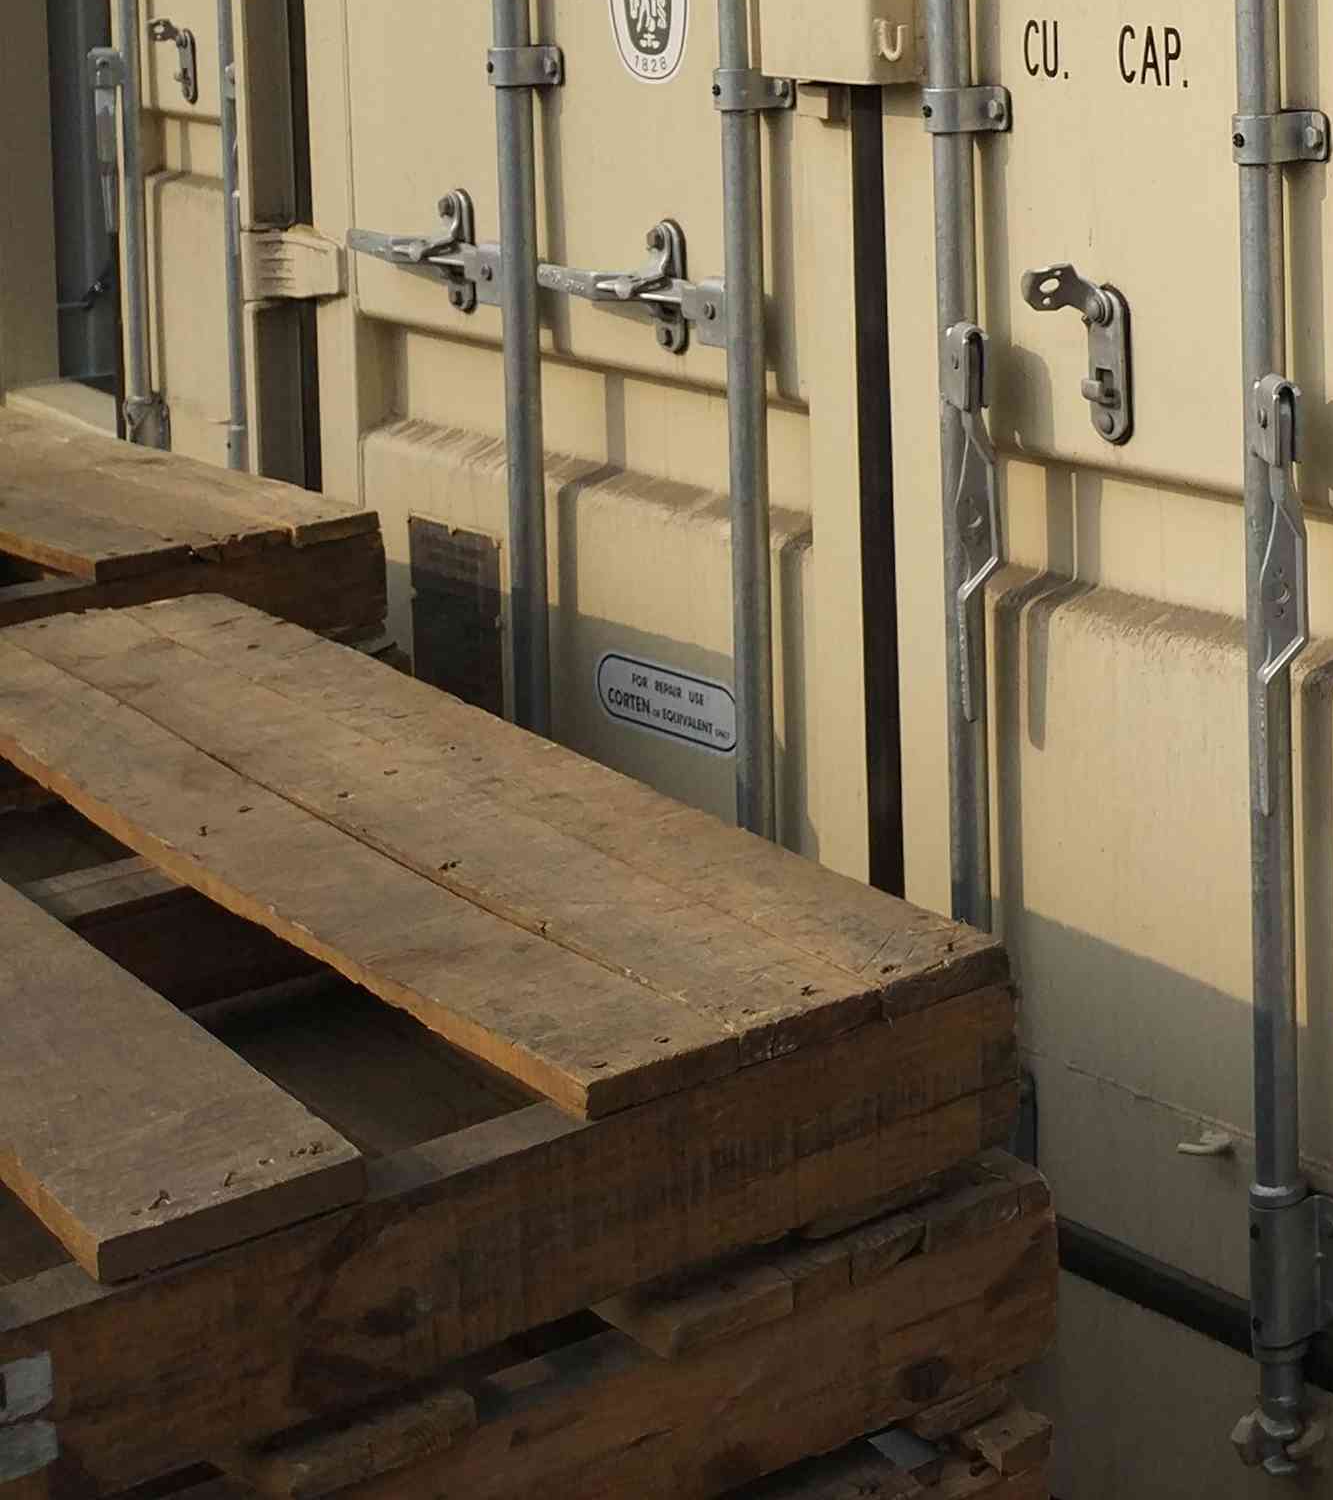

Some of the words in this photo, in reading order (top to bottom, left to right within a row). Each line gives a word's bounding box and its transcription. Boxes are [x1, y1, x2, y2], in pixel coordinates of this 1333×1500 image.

[635, 55, 668, 73] 1828
[1023, 19, 1070, 81] CU.
[1117, 24, 1190, 90] CAP.
[631, 672, 648, 689] FOR
[654, 680, 682, 699] REPAIR
[688, 690, 705, 707] USE
[607, 687, 650, 715] CORTEN
[661, 707, 713, 736] EQUIVALENT
